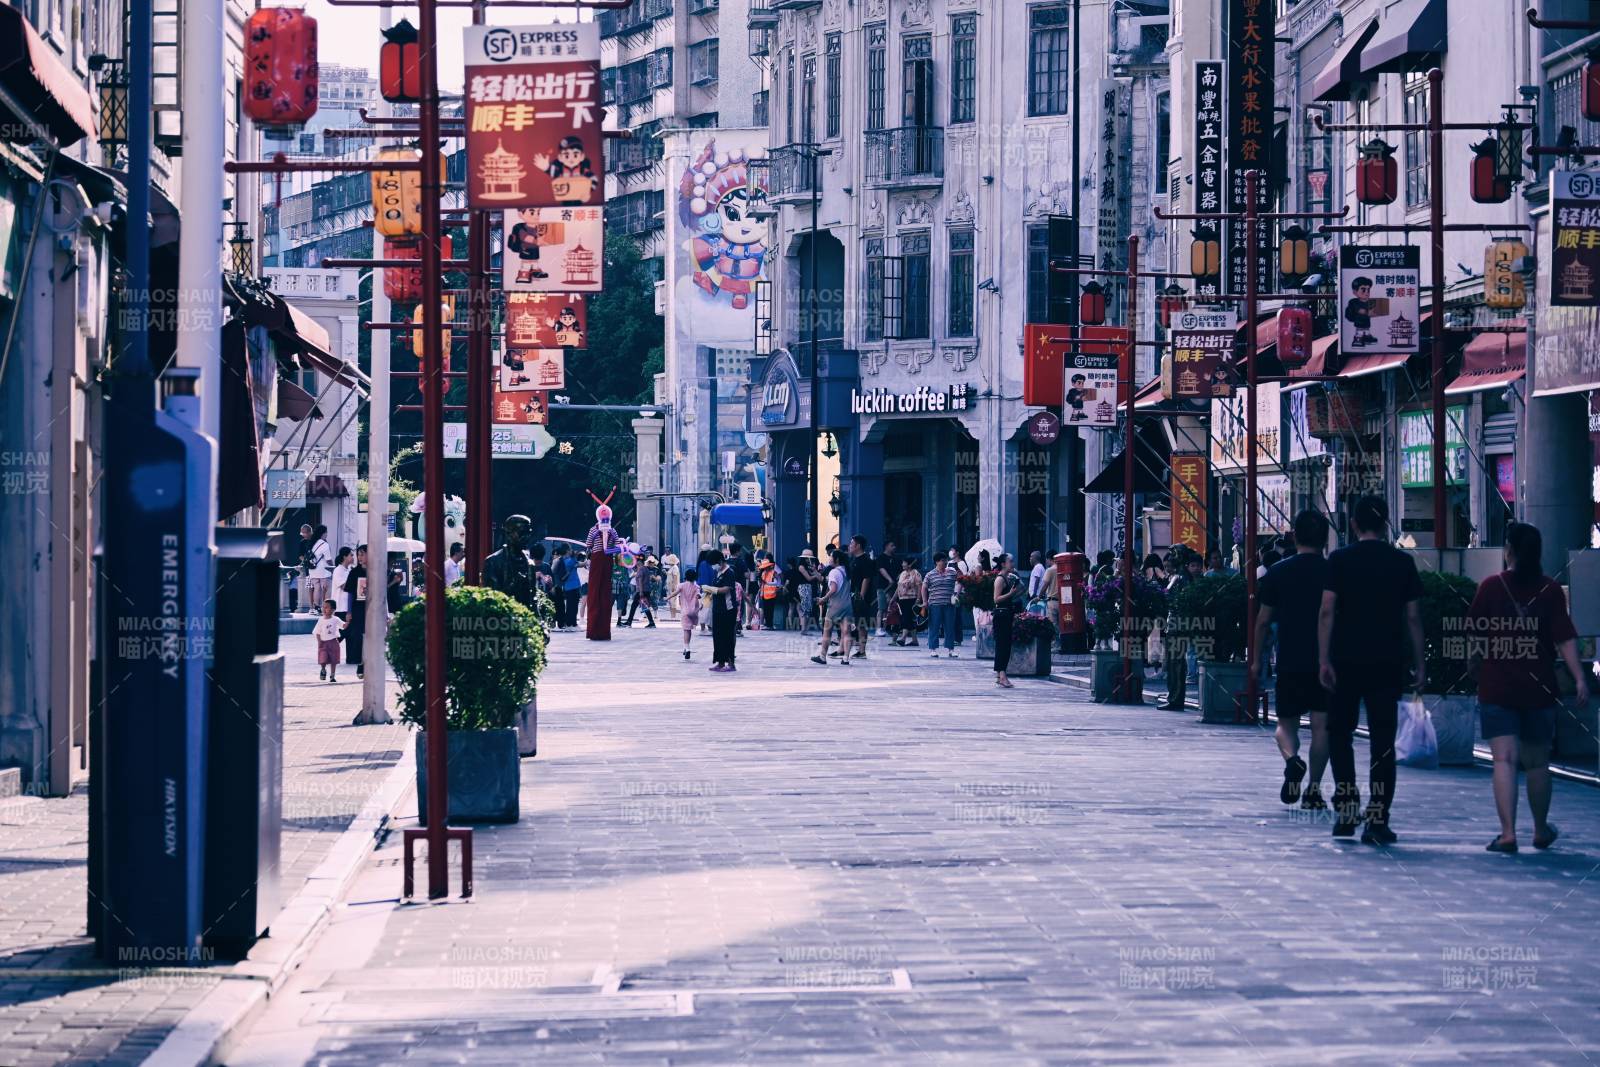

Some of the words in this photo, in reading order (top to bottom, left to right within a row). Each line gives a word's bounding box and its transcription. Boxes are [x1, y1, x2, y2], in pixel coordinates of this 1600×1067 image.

[490, 38, 511, 54] SF
[520, 31, 578, 44] EXPRESS
[520, 45, 579, 56] 顺丰速运
[471, 72, 595, 102] 轻松出行
[472, 102, 595, 132] 顺丰一下
[1573, 179, 1589, 192] SF
[561, 209, 599, 221] 寄顺丰
[1375, 251, 1405, 259] EXPRESS
[1375, 275, 1416, 285] 随时随地
[1386, 287, 1416, 297] 寄顺丰
[1184, 317, 1195, 326] SF
[1175, 335, 1234, 348] 轻松出行
[1175, 349, 1234, 362] 顺丰一下
[852, 388, 894, 413] luckin
[898, 386, 945, 413] coffee
[1180, 463, 1199, 544] 手绘汕头
[163, 534, 179, 680] EMERGENCY
